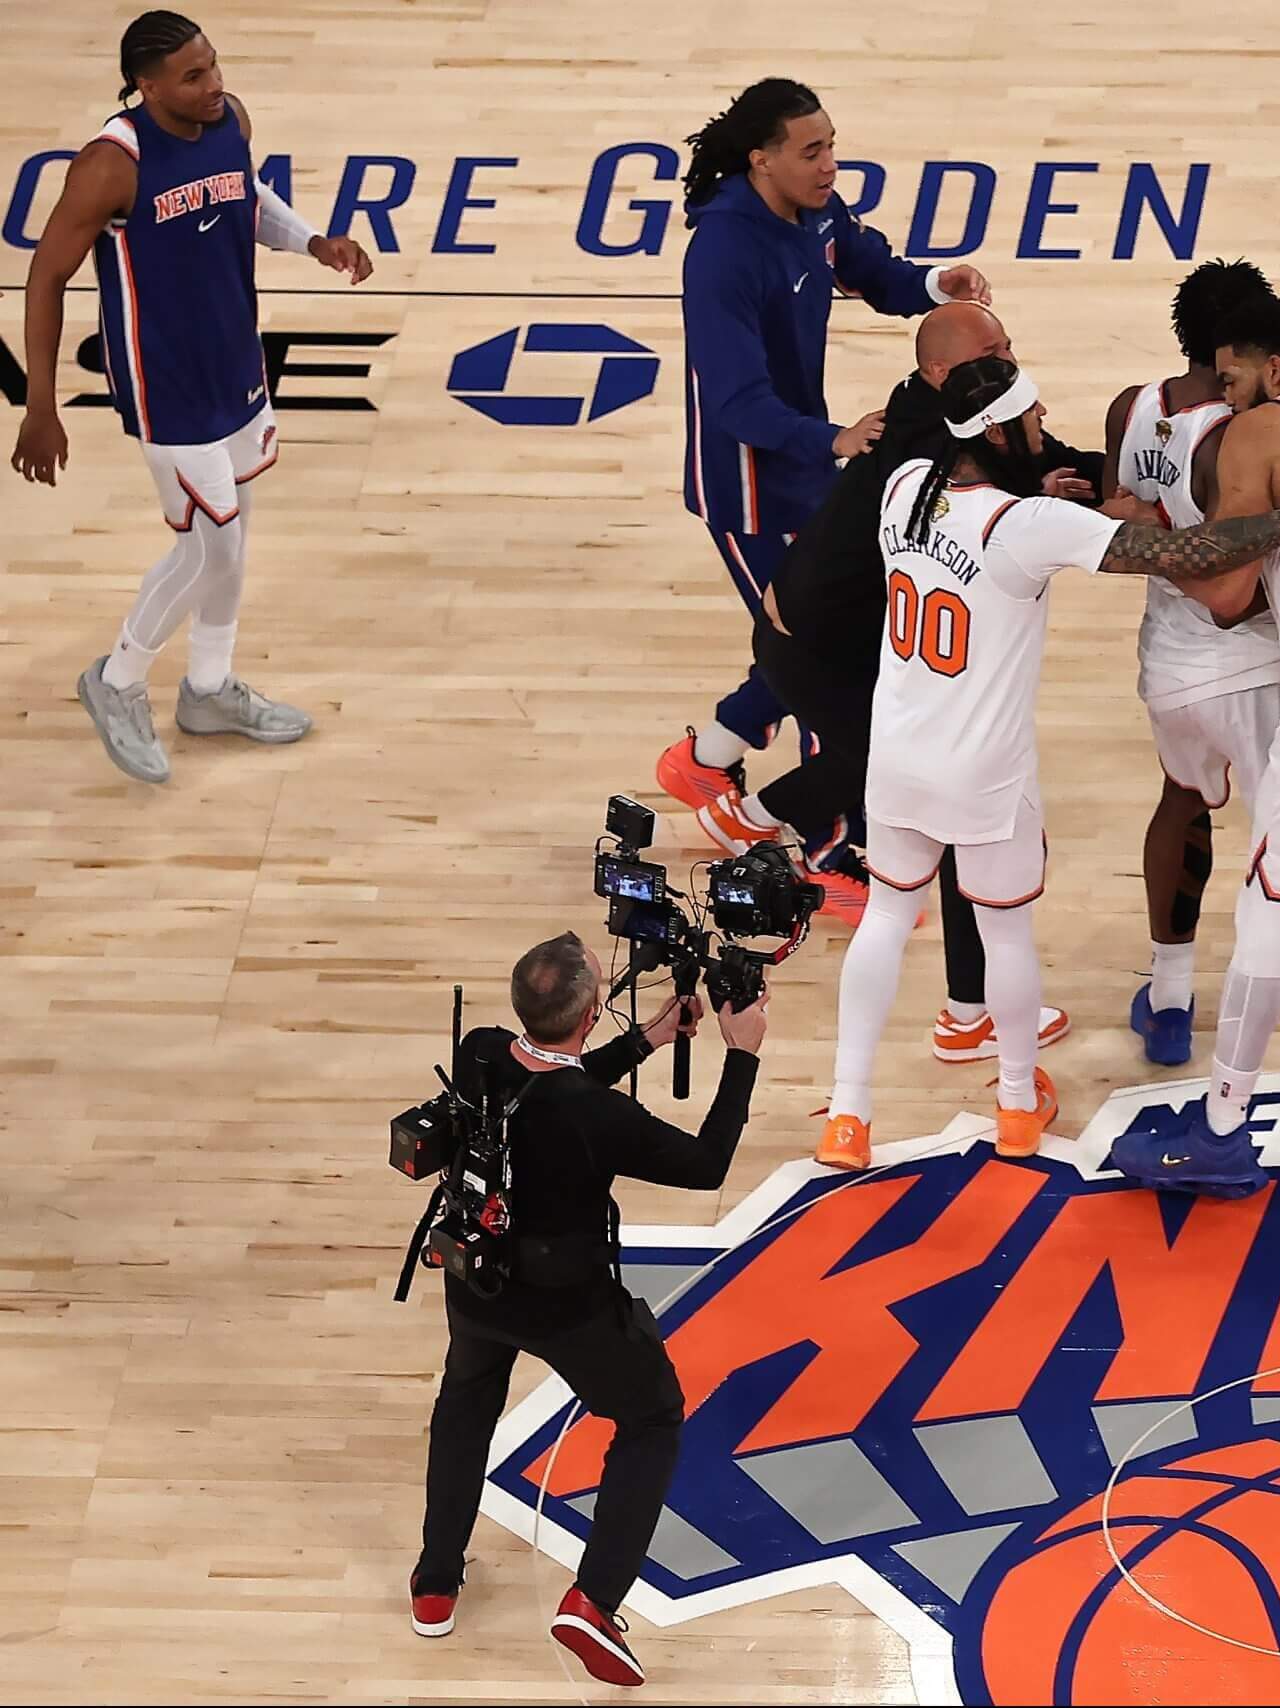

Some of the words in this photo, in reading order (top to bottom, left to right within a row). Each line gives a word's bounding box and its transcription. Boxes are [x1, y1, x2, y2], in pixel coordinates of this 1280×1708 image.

[153, 179, 204, 224] NEW
[575, 142, 1209, 260] GDEN
[888, 568, 971, 678] 00
